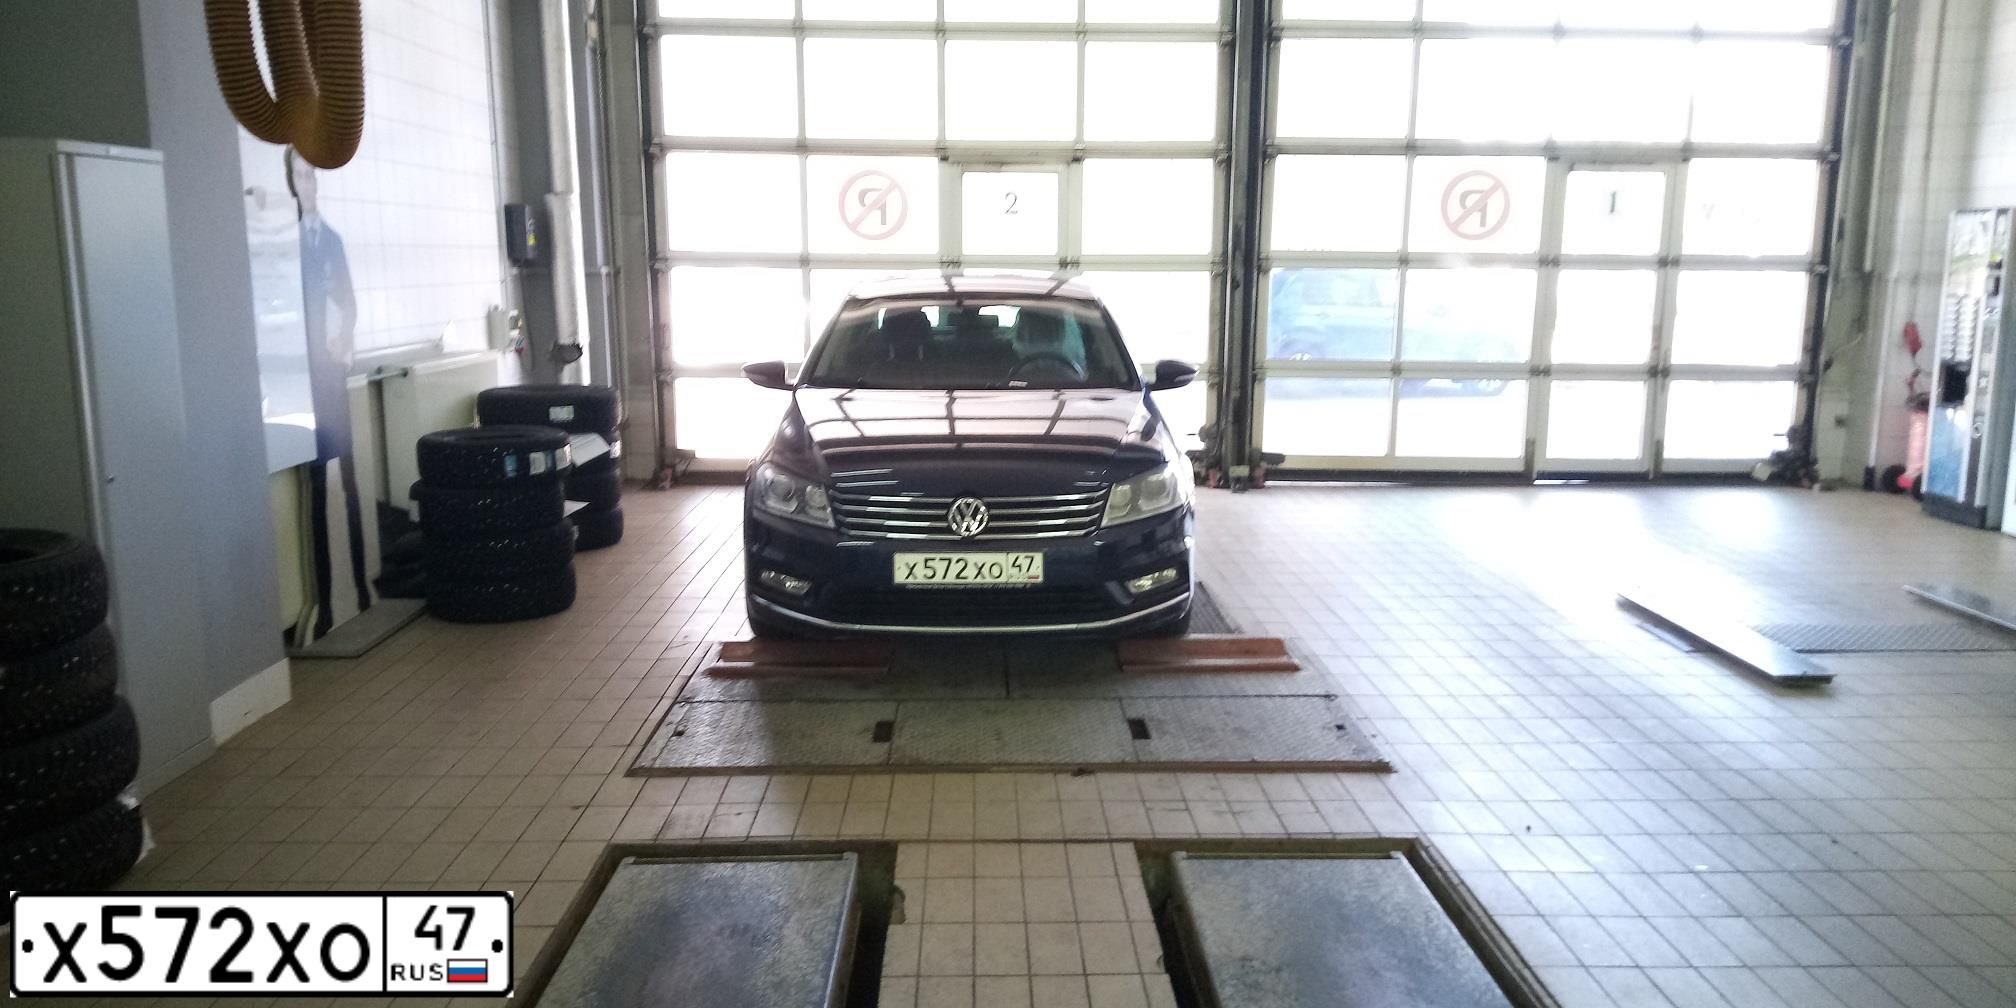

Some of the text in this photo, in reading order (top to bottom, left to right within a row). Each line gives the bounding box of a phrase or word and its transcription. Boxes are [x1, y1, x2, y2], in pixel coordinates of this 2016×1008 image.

[1004, 191, 1018, 215] 2
[904, 555, 1034, 580] X572XO 47
